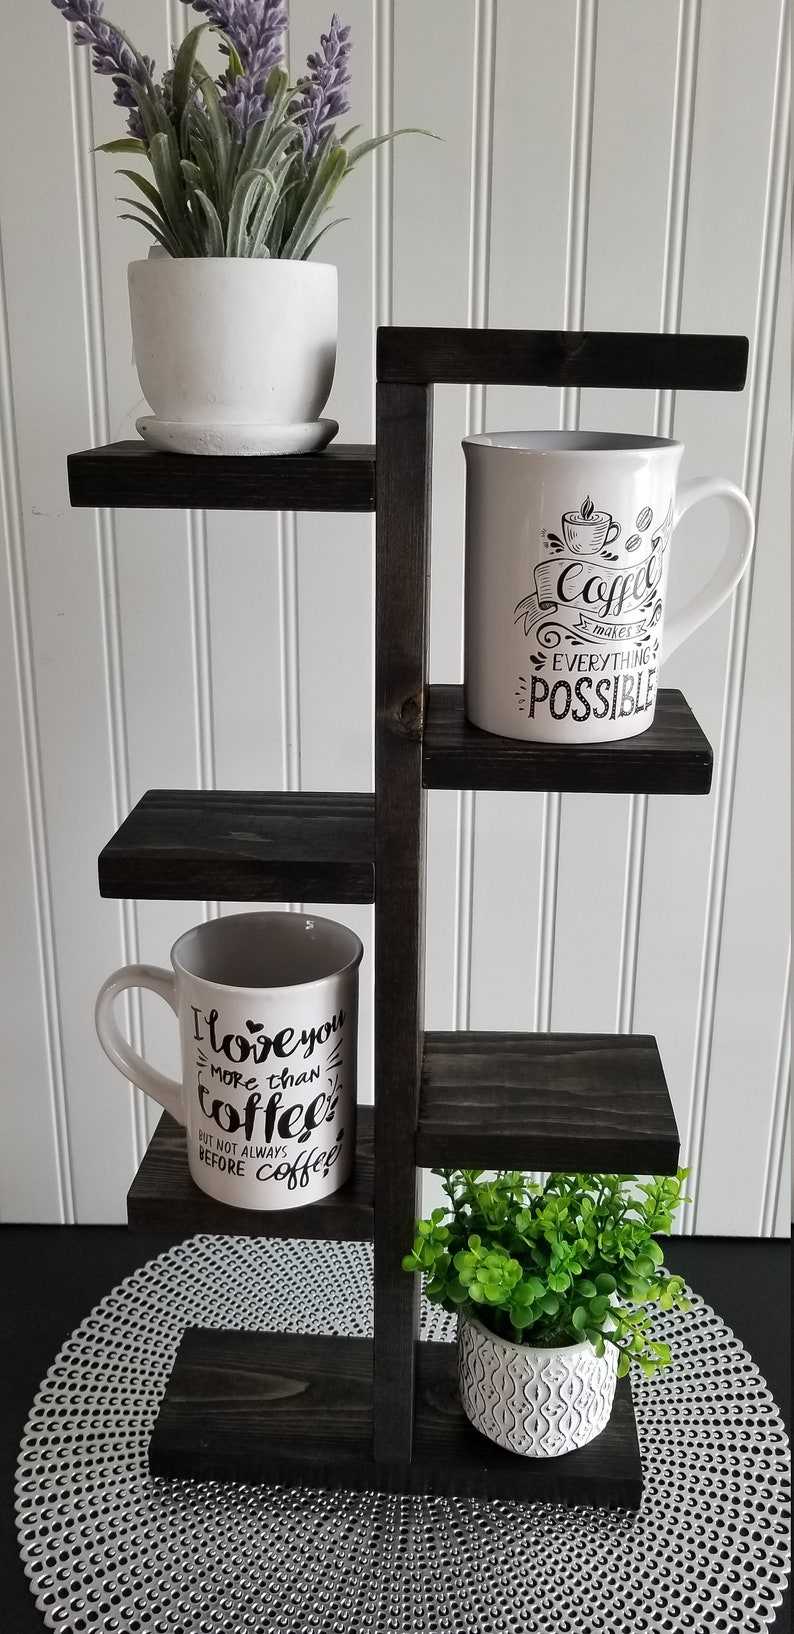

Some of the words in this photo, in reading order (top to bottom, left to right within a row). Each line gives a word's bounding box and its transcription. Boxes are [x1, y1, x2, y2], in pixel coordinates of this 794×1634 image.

[592, 623, 632, 639] makes
[552, 646, 651, 672] EVERYTHING
[527, 668, 656, 722] POSSIBLE
[190, 1005, 204, 1041] I
[204, 1008, 300, 1065] love
[299, 1009, 346, 1059] you
[198, 1128, 214, 1147] BUT
[216, 1138, 238, 1156] NOT
[240, 1145, 288, 1160] ALWAYS
[199, 1145, 246, 1177] BEFORE
